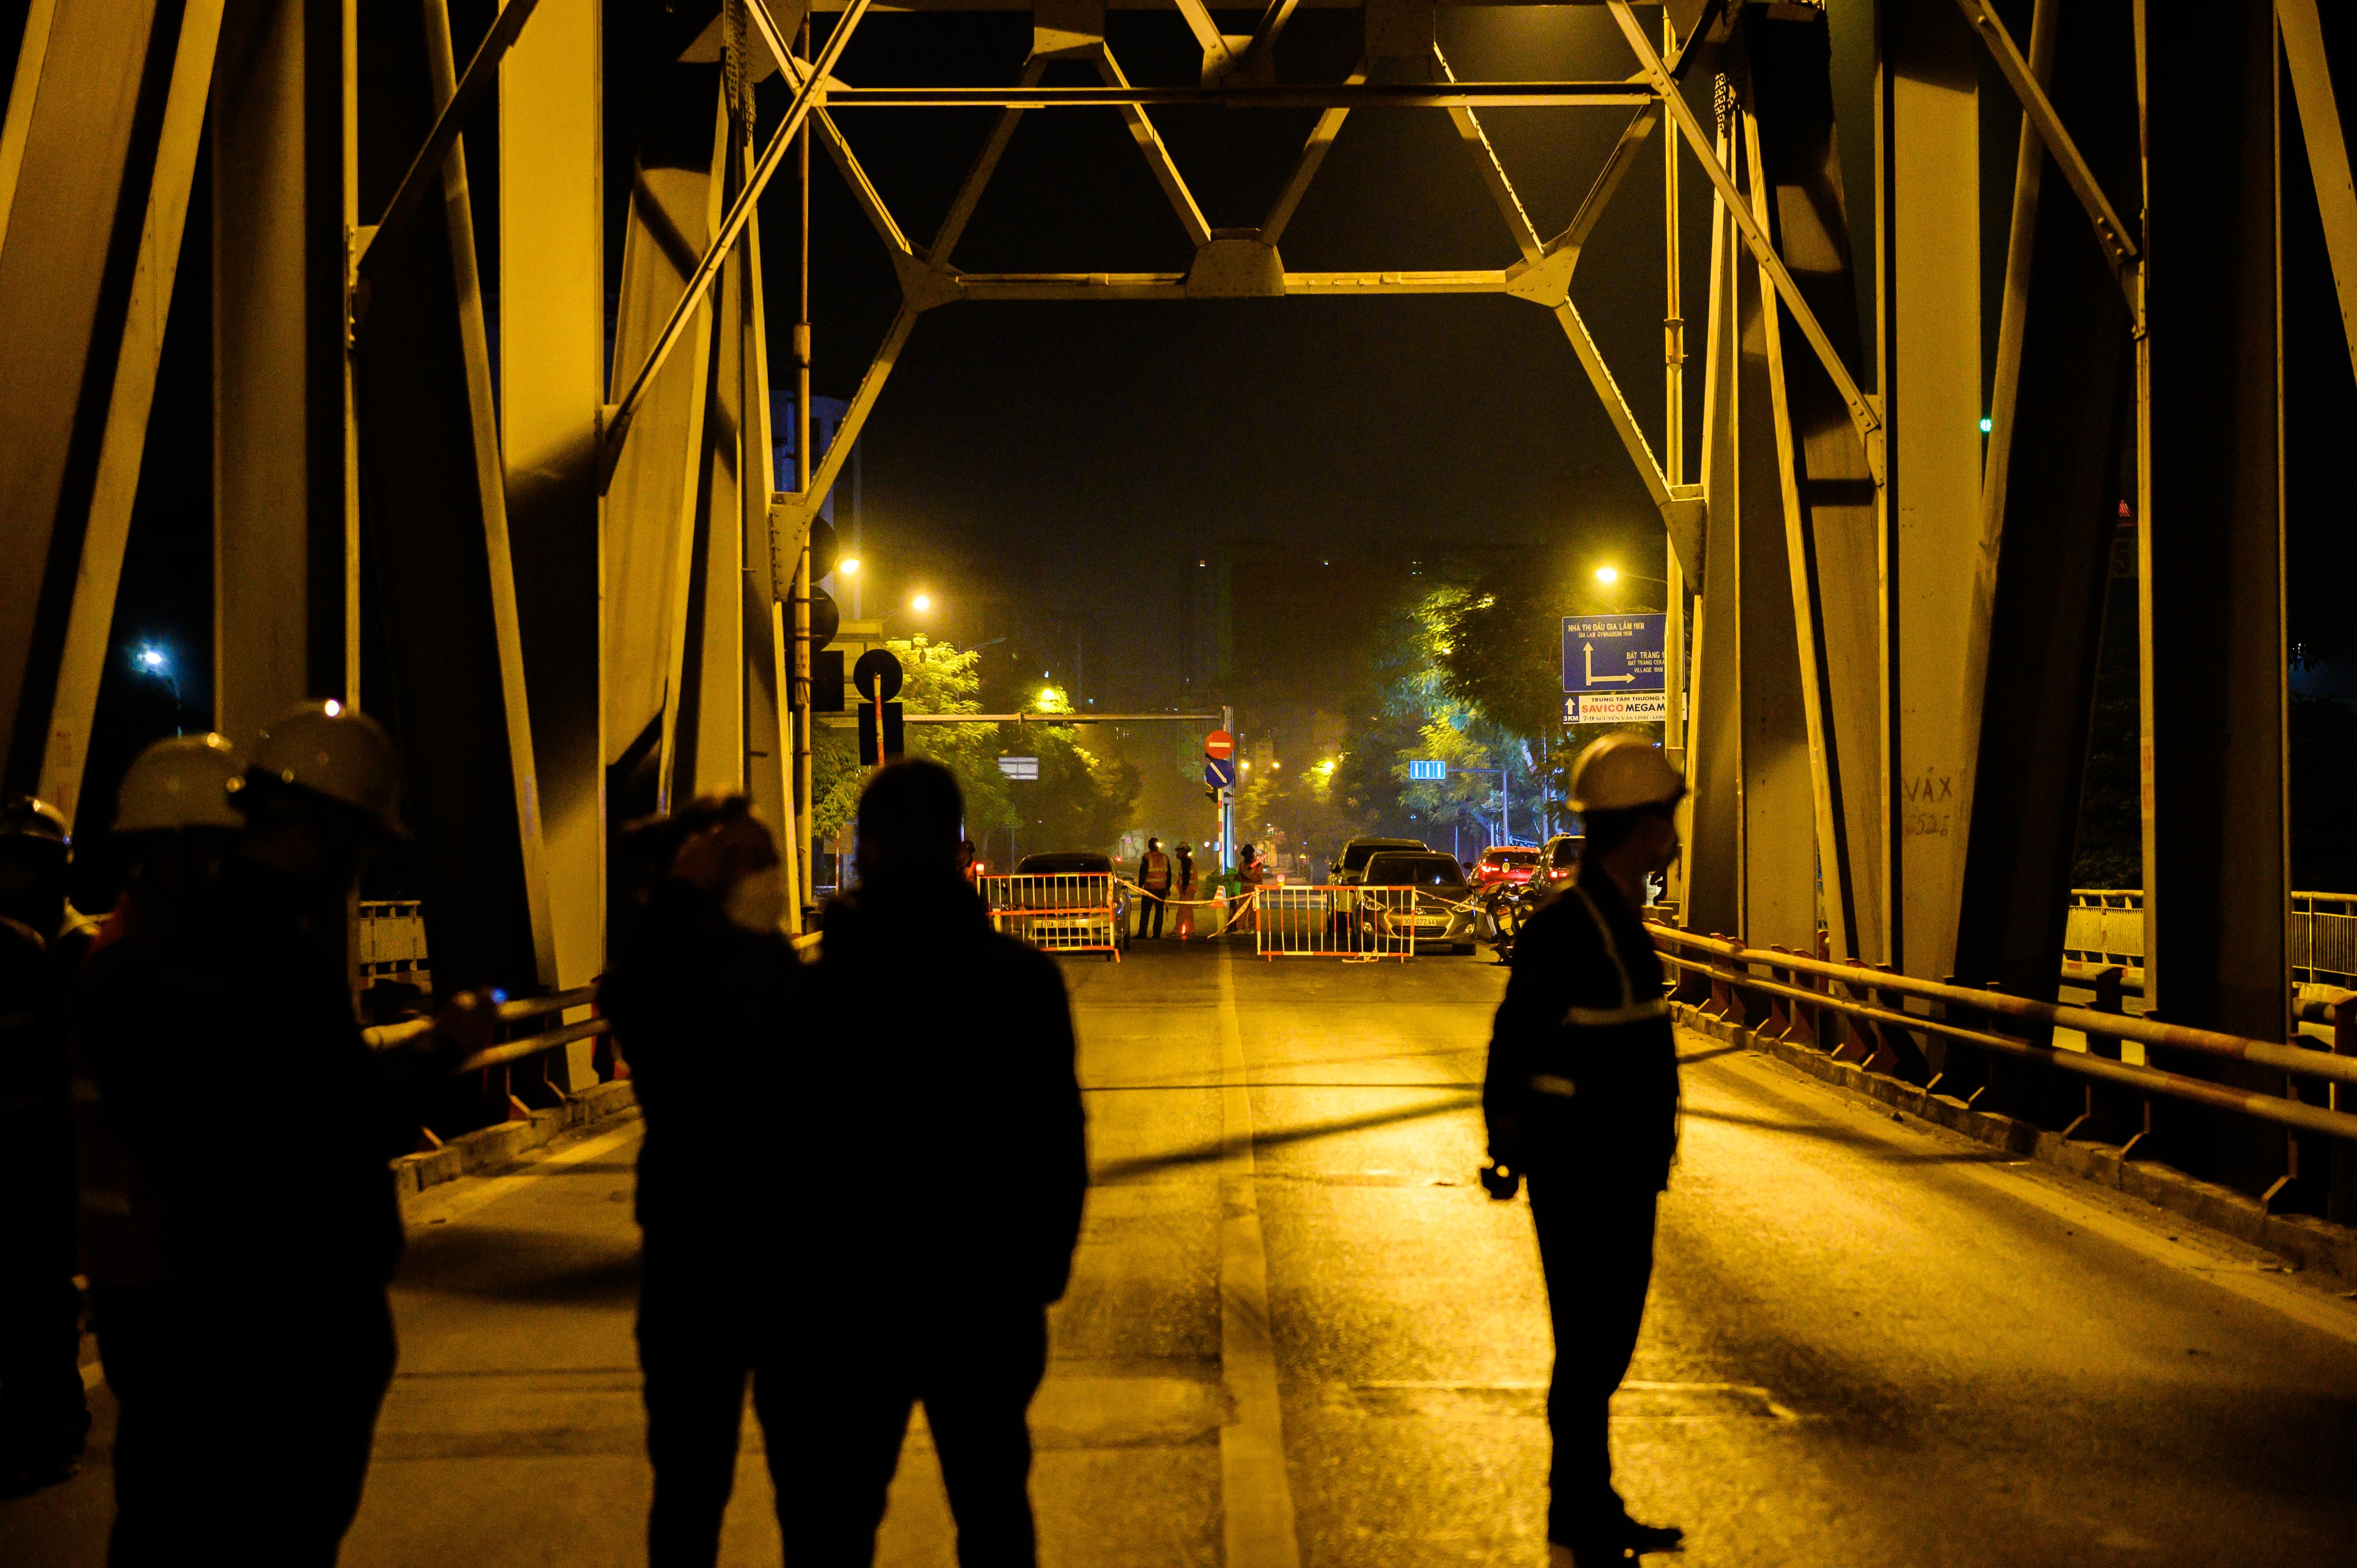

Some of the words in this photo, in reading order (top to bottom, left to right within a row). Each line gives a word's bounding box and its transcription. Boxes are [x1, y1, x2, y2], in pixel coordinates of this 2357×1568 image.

[1569, 623, 1580, 632] NHÀ
[1620, 621, 1632, 630] LÂM
[1582, 704, 1624, 713] SAVICO
